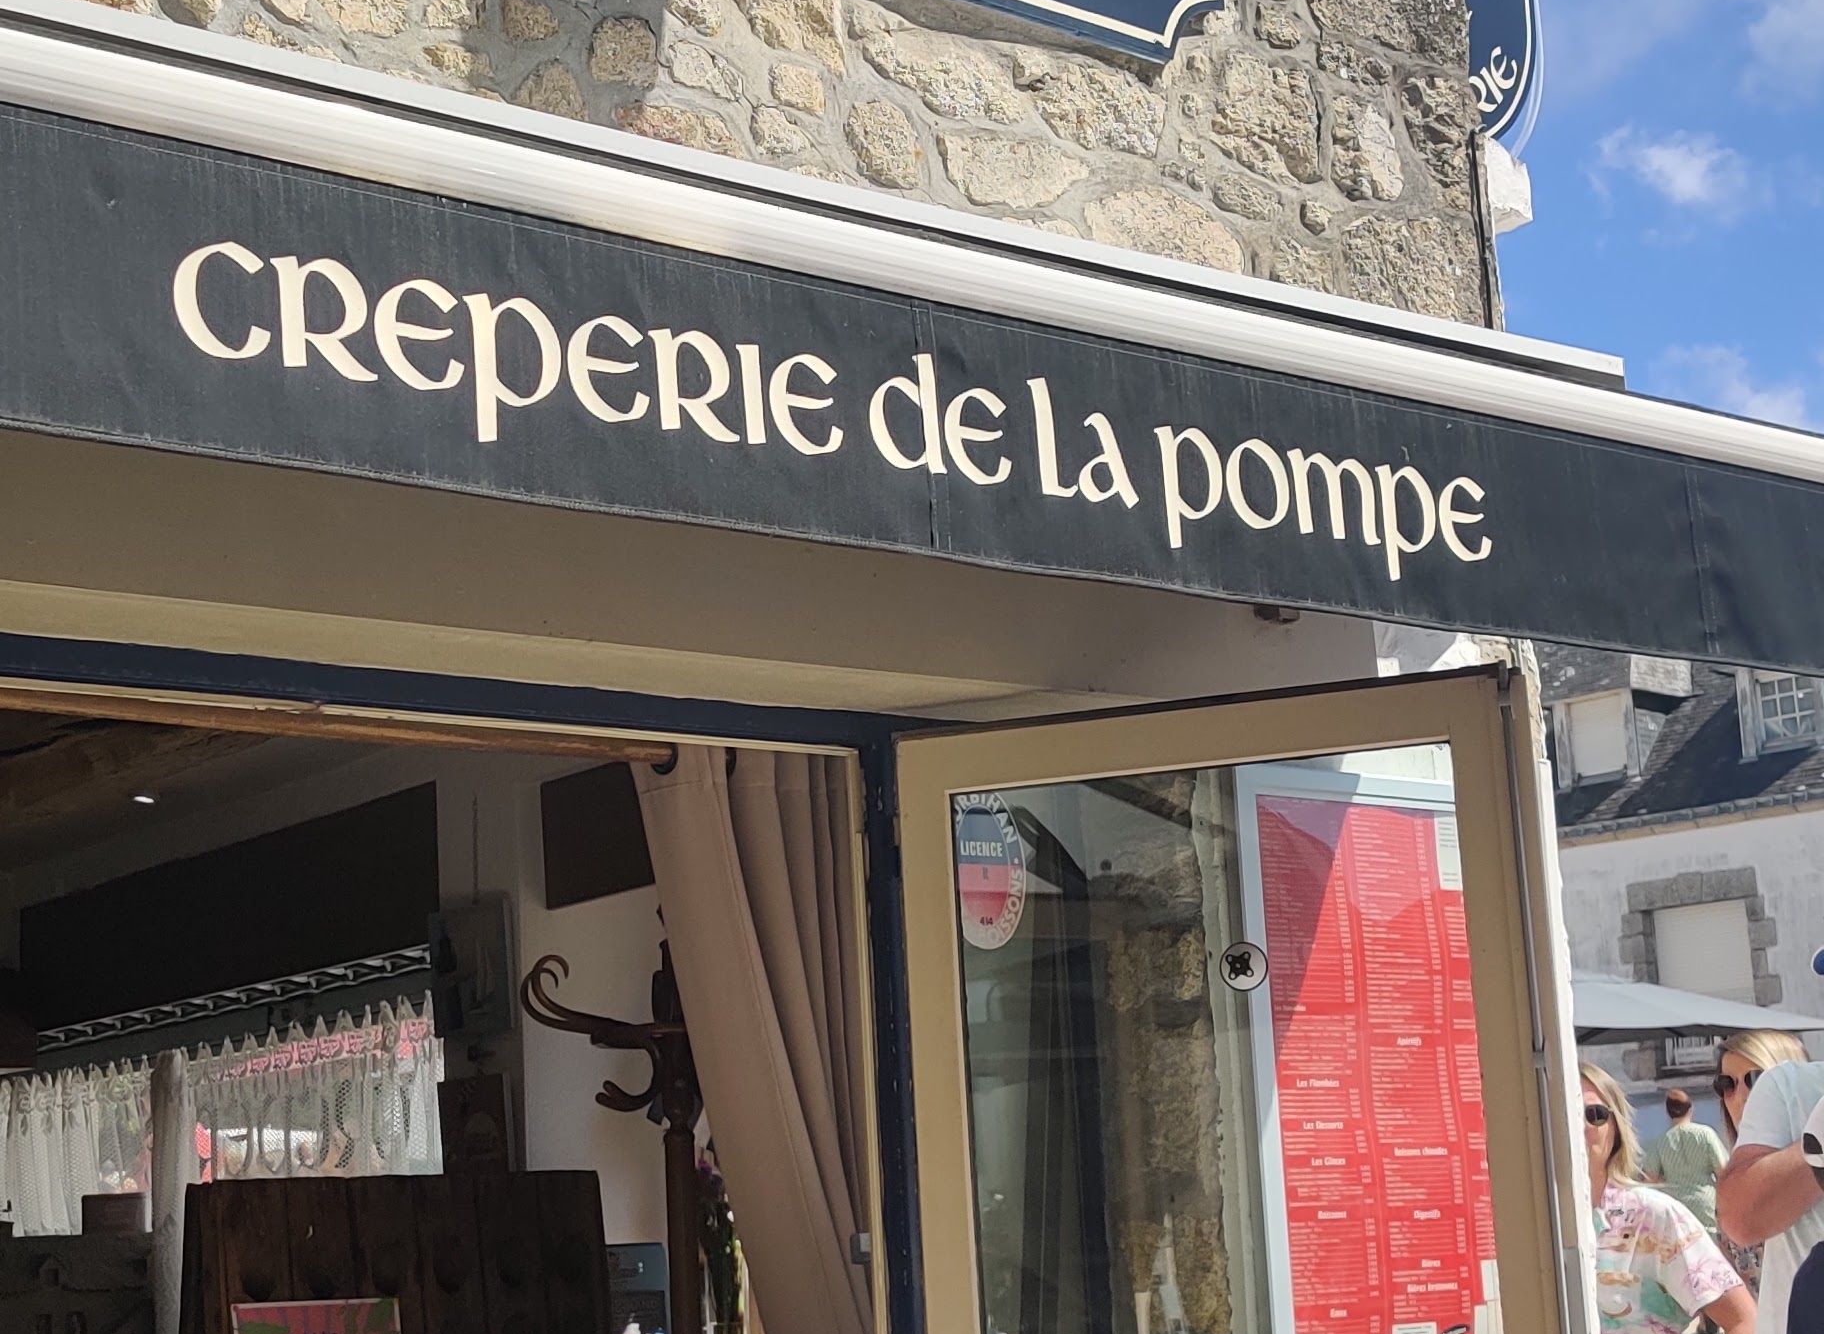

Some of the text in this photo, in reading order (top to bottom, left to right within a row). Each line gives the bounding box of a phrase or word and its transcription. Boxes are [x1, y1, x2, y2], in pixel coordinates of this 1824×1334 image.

[172, 241, 845, 456] CREPERIE
[868, 353, 1013, 486] de
[1026, 377, 1140, 510] la
[954, 793, 1018, 844] ORBIHAN
[960, 840, 1003, 857] LICENCE
[986, 868, 1024, 943] OISSONS
